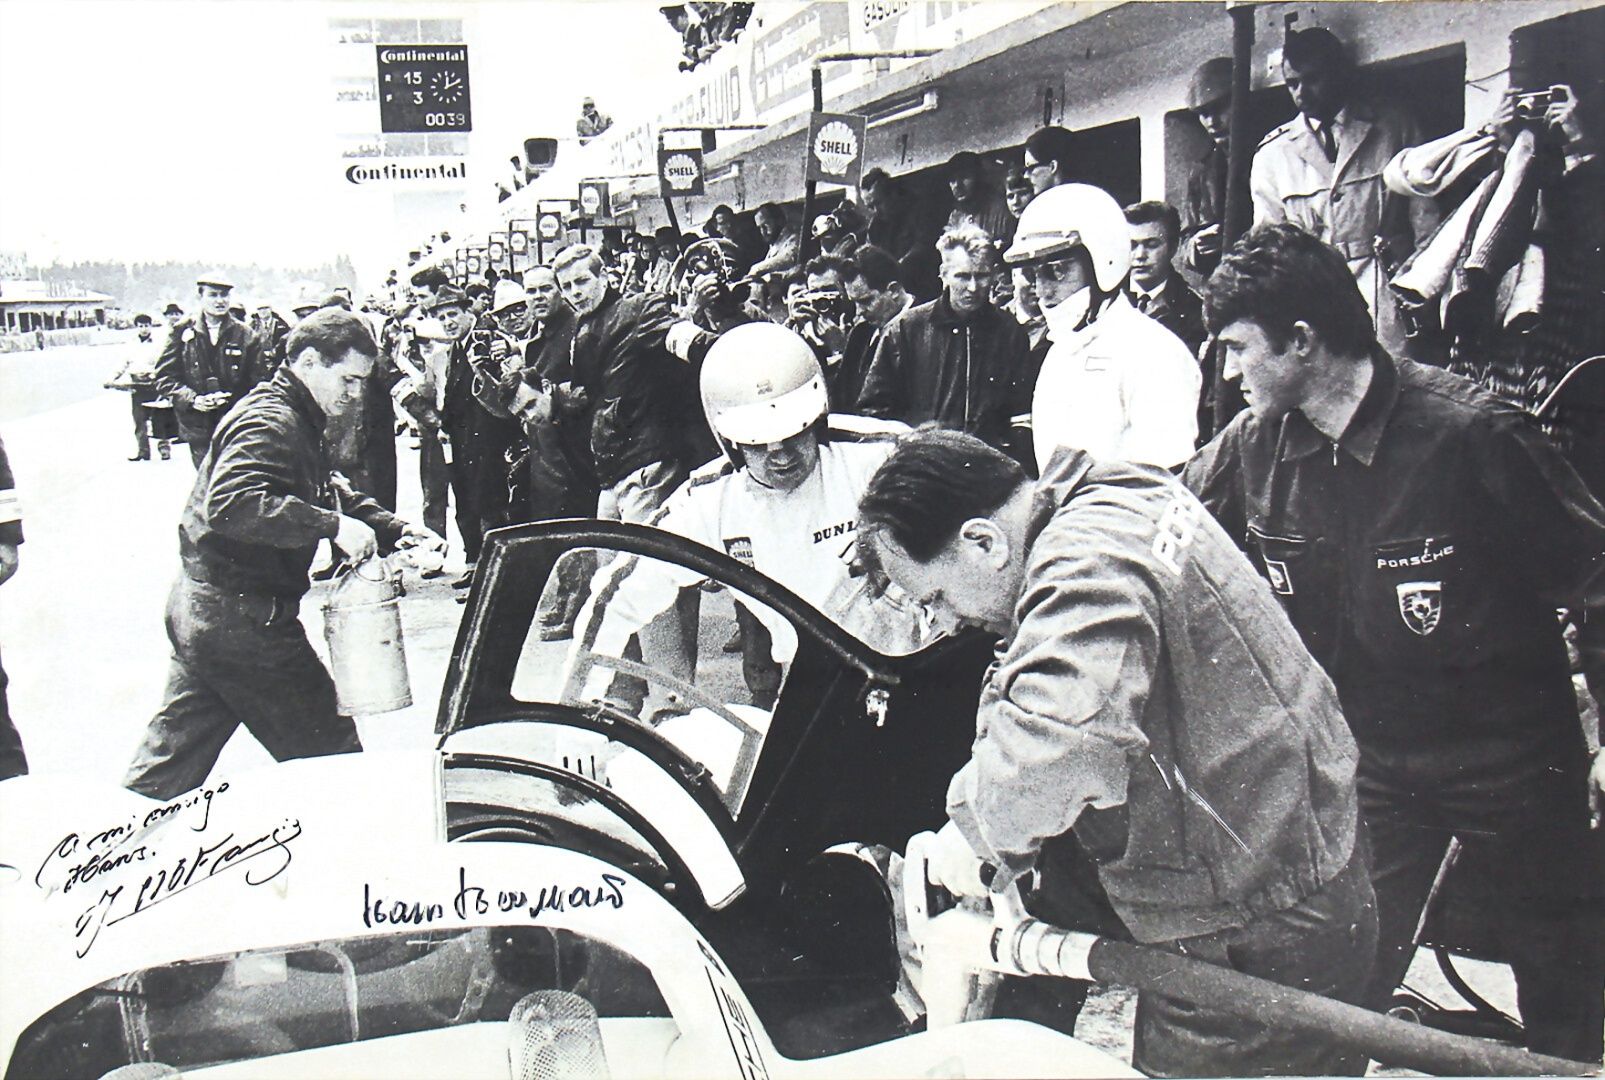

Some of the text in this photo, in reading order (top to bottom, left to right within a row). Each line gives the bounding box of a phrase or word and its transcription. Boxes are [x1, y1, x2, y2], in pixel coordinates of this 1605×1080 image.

[380, 49, 465, 64] Continental
[403, 71, 423, 85] 15
[413, 91, 424, 105] 3
[425, 113, 465, 127] 0039
[820, 140, 852, 156] SHELL
[345, 162, 466, 185] Continental
[668, 166, 695, 177] SHELL
[812, 520, 859, 544] DUNL
[1377, 545, 1454, 569] PORSCHE
